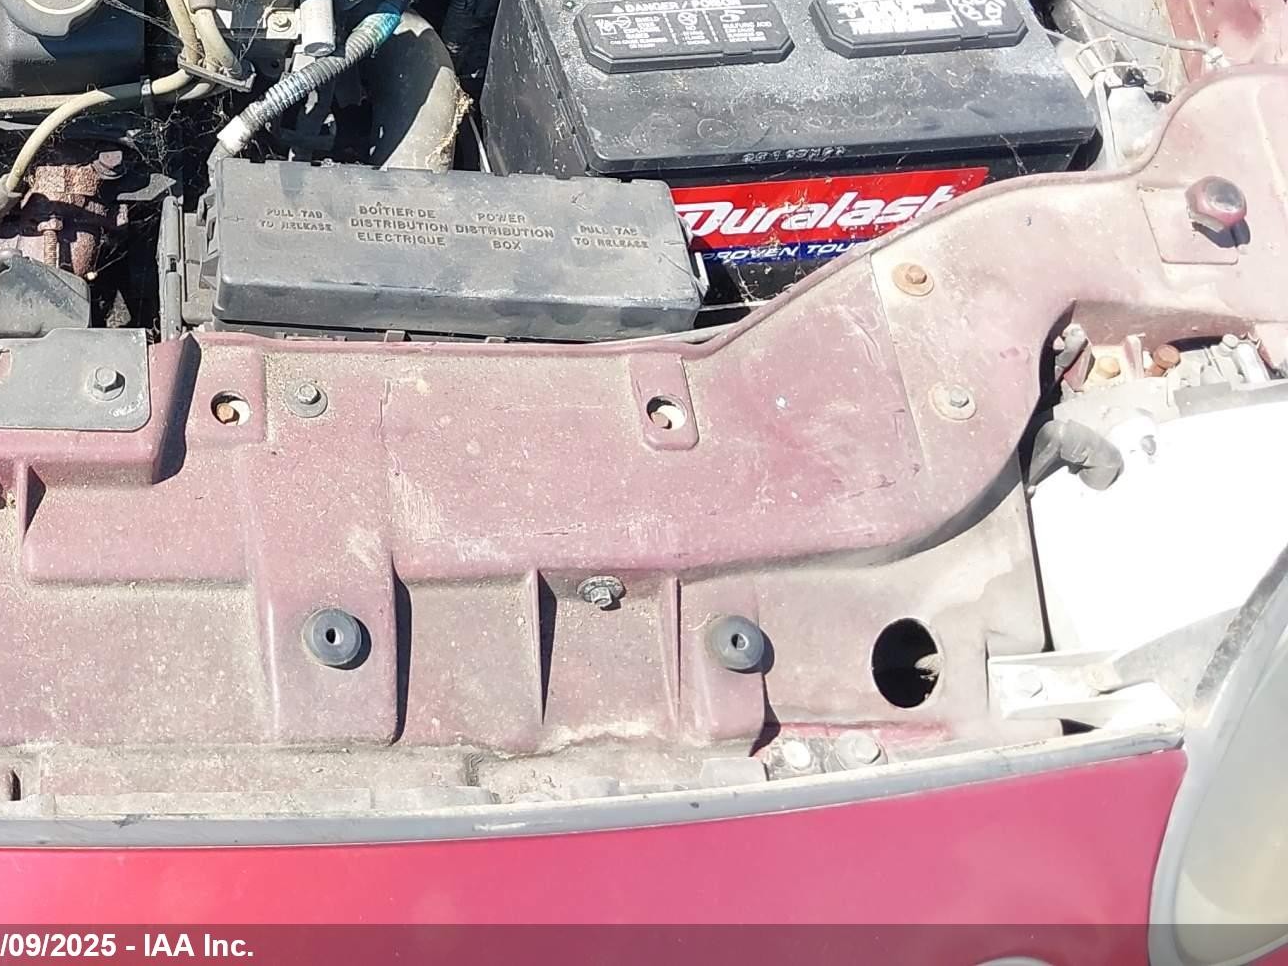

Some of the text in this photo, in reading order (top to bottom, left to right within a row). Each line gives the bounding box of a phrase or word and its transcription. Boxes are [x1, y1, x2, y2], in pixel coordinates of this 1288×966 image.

[624, 1, 680, 12] DANGER
[358, 201, 437, 219] BOÎTIER DE
[674, 186, 954, 236] Duralast
[477, 213, 527, 224] POWER
[350, 218, 449, 233] DISTRIBUTION
[455, 224, 555, 239] DISTRIBUTION
[492, 240, 522, 251] BOX
[573, 237, 590, 246] TO
